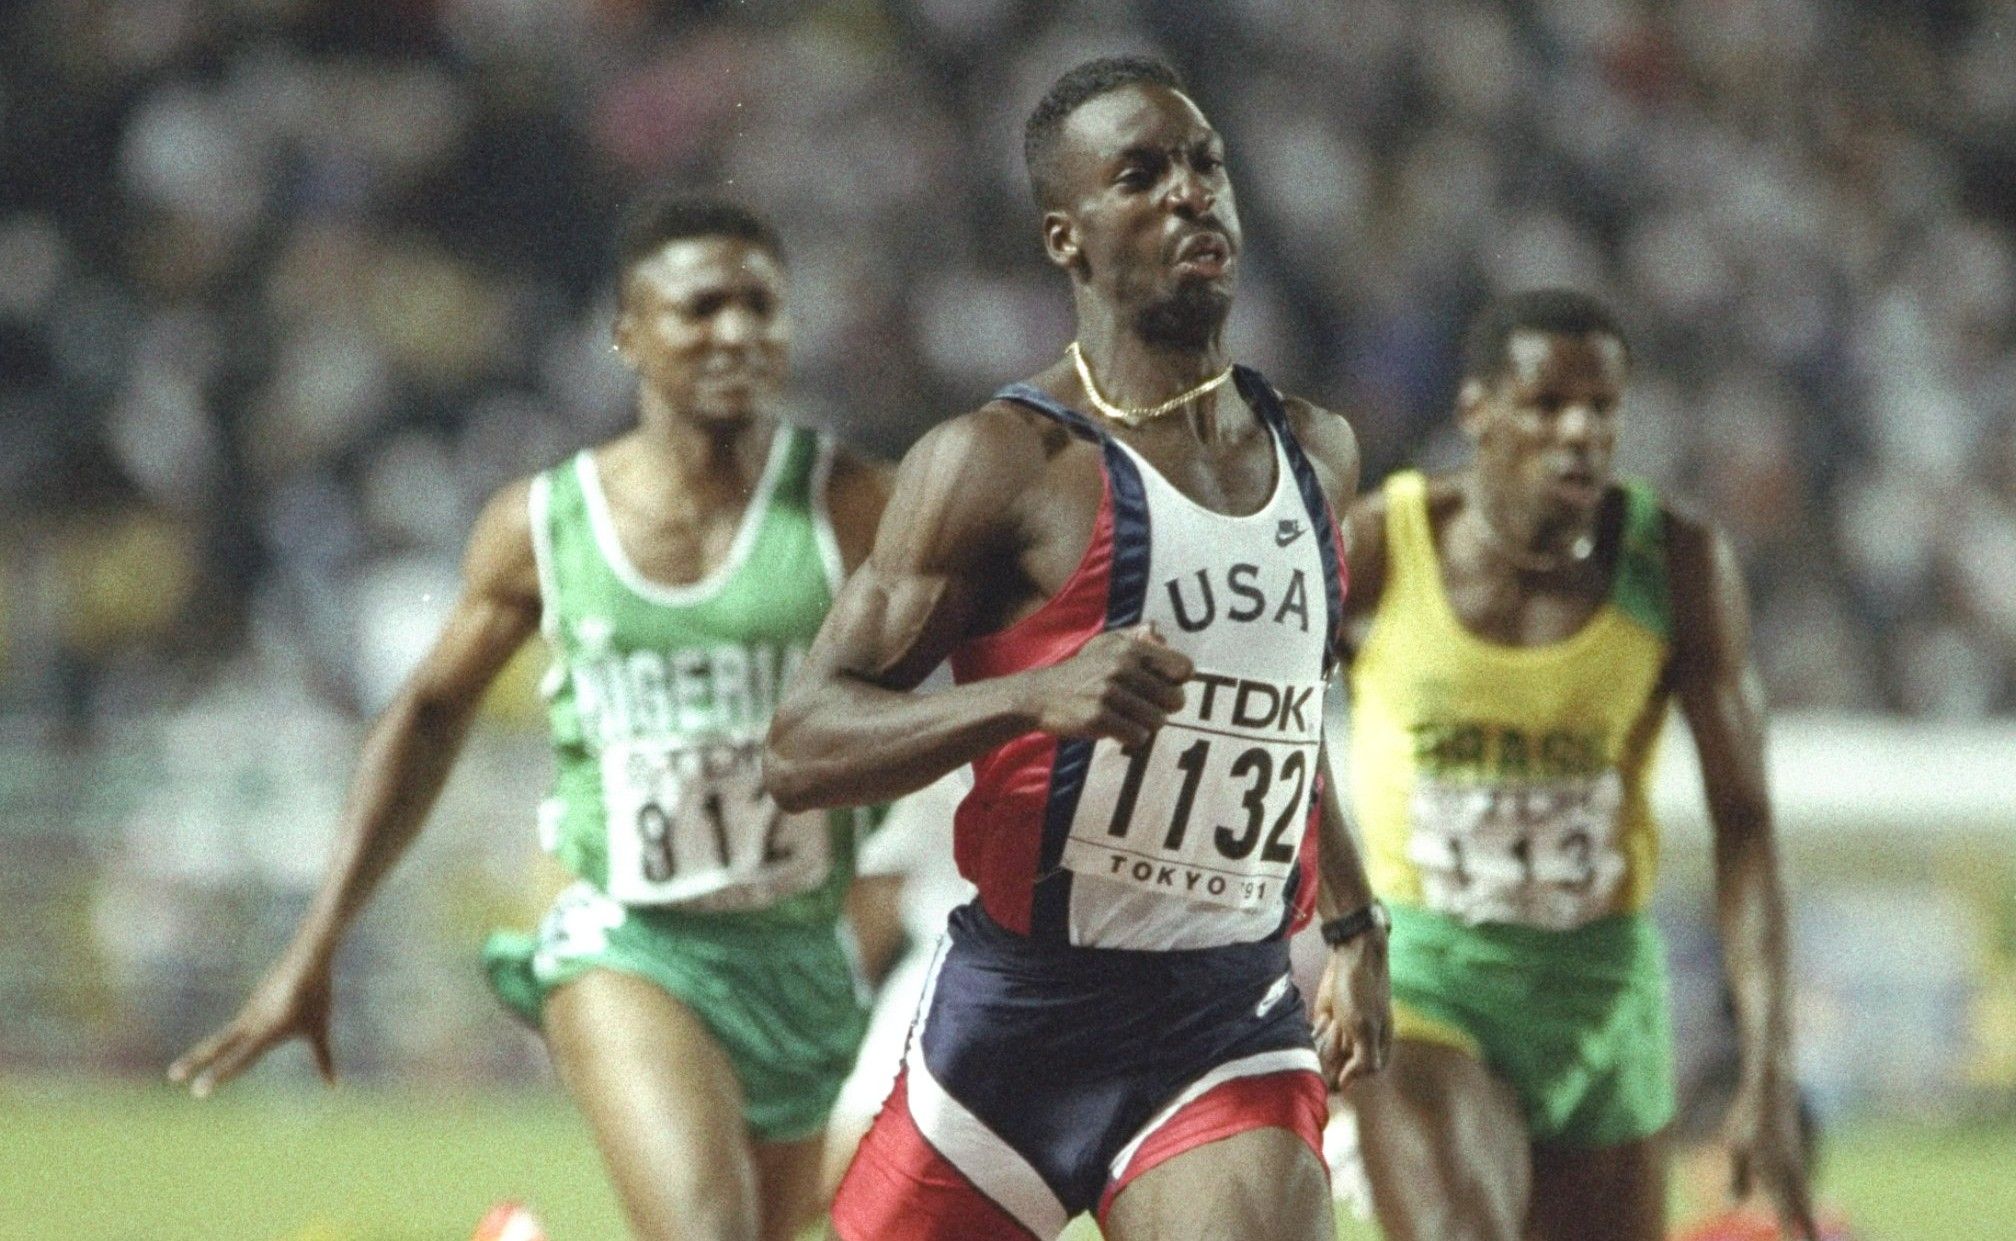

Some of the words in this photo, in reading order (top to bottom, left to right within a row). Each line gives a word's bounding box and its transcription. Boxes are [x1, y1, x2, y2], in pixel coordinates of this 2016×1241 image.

[1165, 563, 1310, 634] USA
[1192, 671, 1315, 733] TDK
[1107, 732, 1308, 864] 1132
[1110, 854, 1226, 896] TOKYO
[1241, 881, 1267, 900] '91
